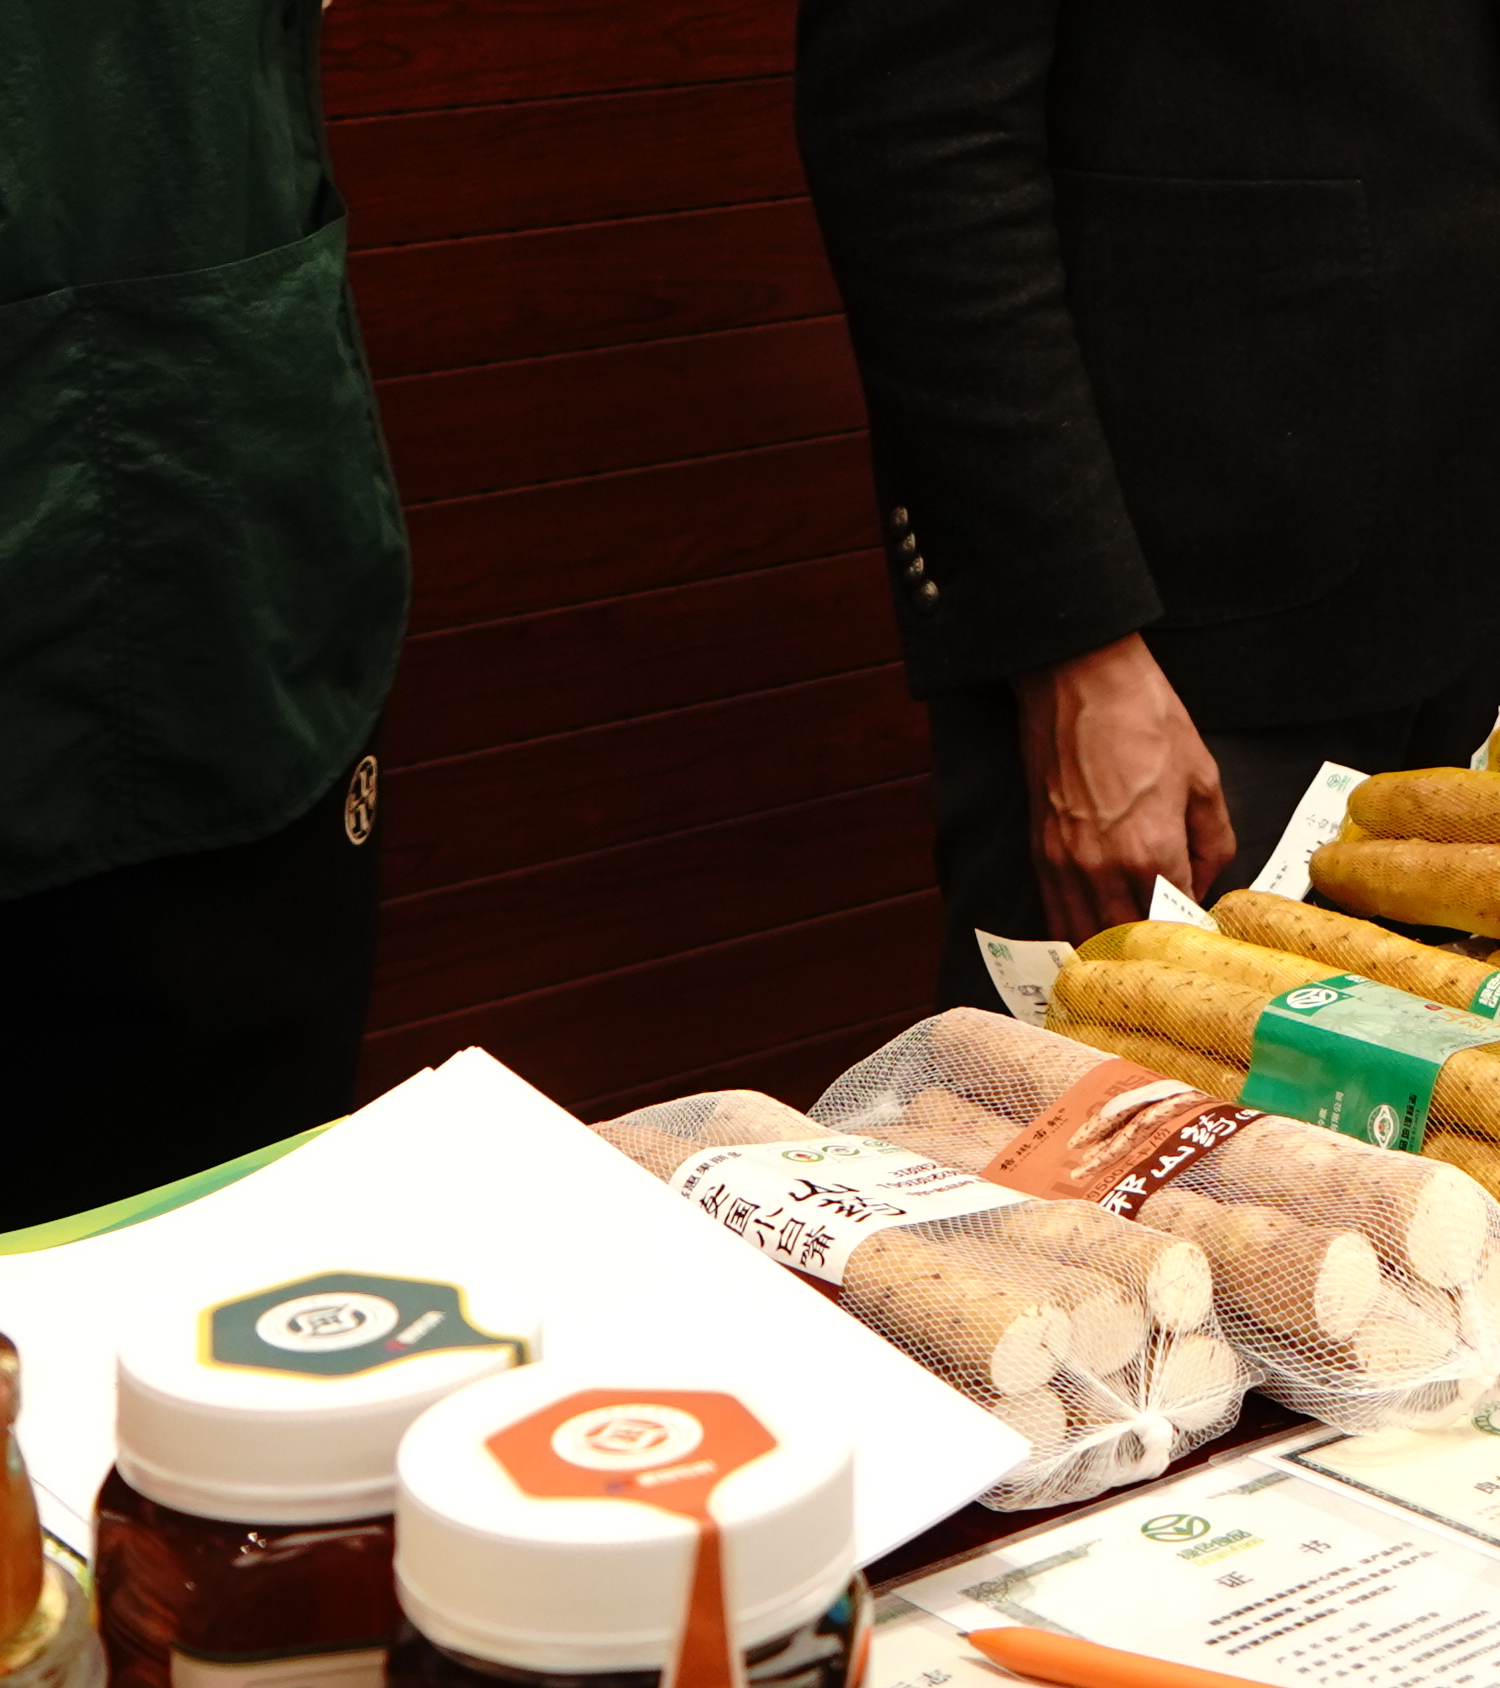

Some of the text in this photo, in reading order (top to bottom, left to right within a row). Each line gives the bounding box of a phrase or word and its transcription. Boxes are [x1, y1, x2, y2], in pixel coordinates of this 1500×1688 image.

[1099, 1112, 1238, 1216] 祁山药
[700, 1184, 835, 1267] 安国小白嘴
[788, 1178, 907, 1223] 山药
[1214, 1539, 1332, 1589] 证 书
